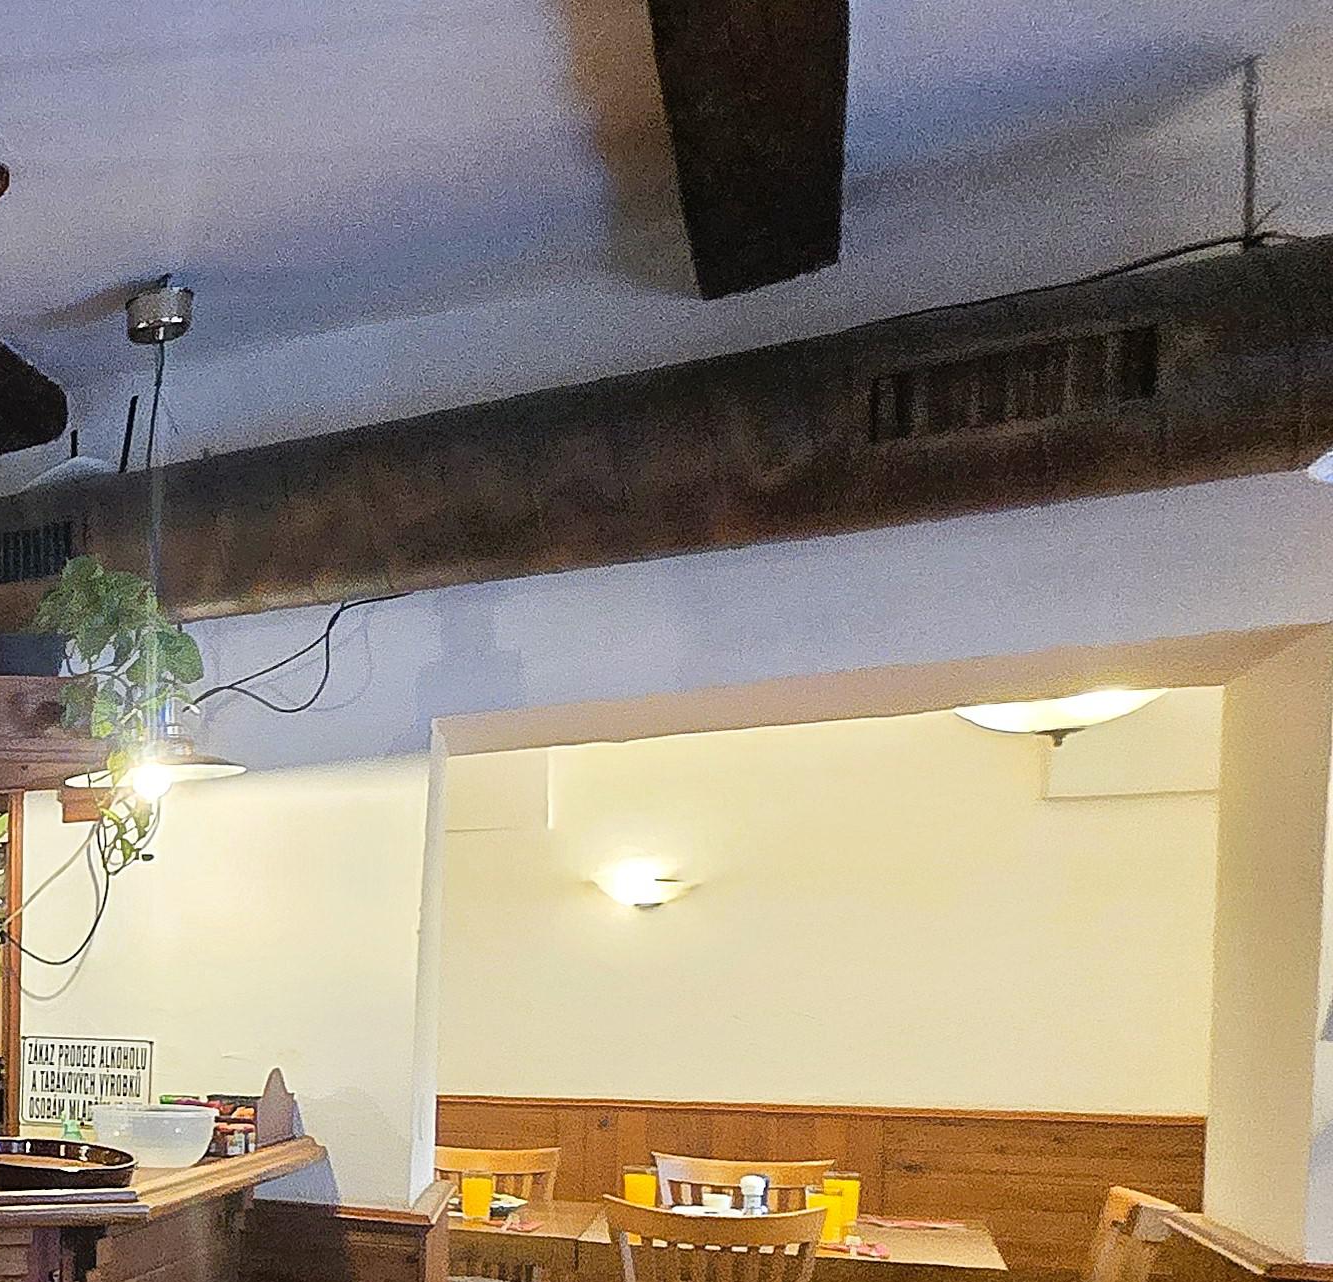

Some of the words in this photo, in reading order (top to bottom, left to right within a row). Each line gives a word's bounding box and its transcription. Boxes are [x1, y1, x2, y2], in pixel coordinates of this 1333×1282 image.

[28, 1039, 55, 1065] ZÁKAZ
[58, 1044, 96, 1068] PRODEJE
[99, 1045, 148, 1070] ALKOHOLU
[31, 1070, 37, 1092] A
